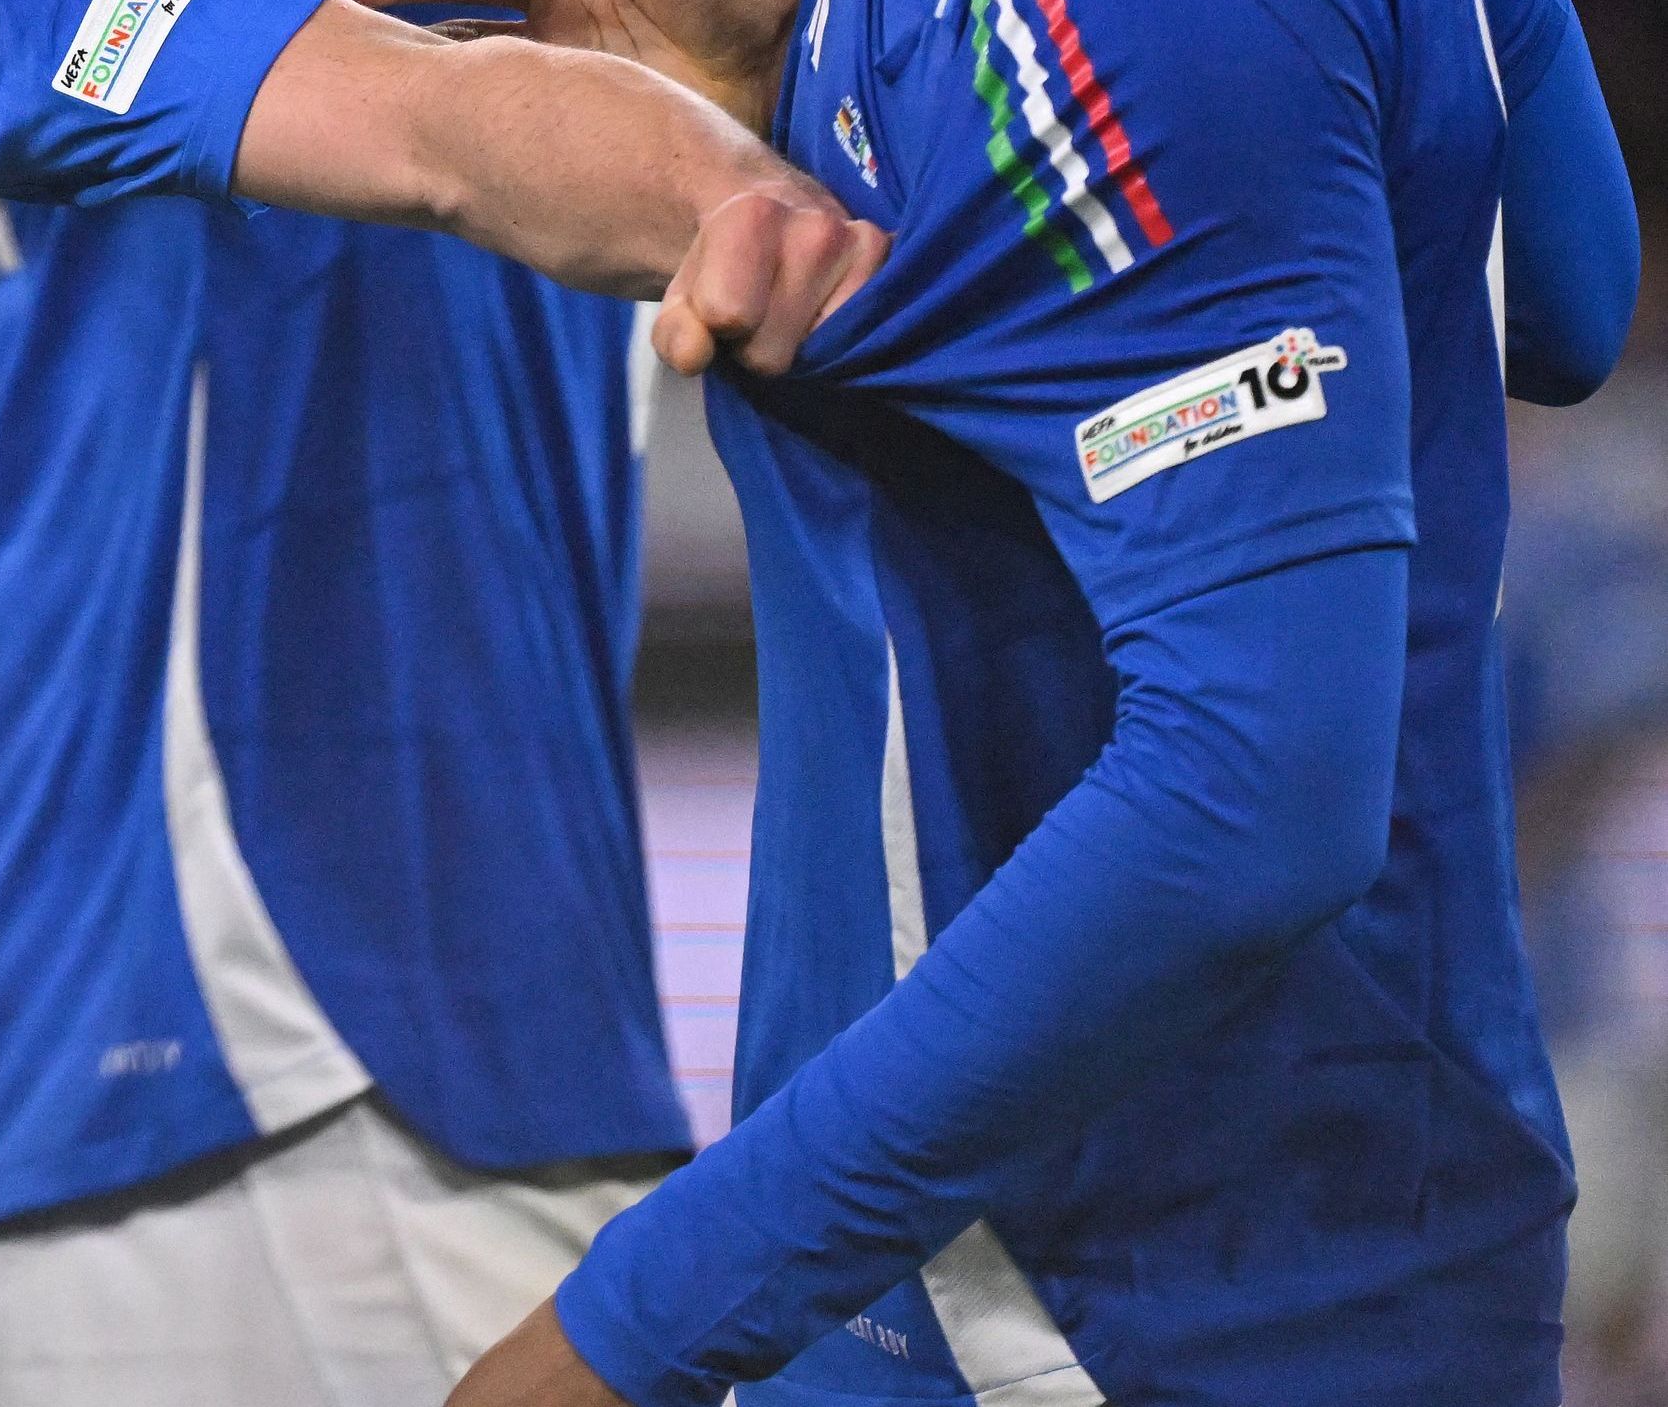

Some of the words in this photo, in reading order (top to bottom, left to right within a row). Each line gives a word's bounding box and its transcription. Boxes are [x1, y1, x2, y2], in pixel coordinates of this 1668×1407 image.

[161, 0, 176, 17] for
[60, 48, 89, 89] UEFA
[1085, 391, 1238, 472] FOUNDATION
